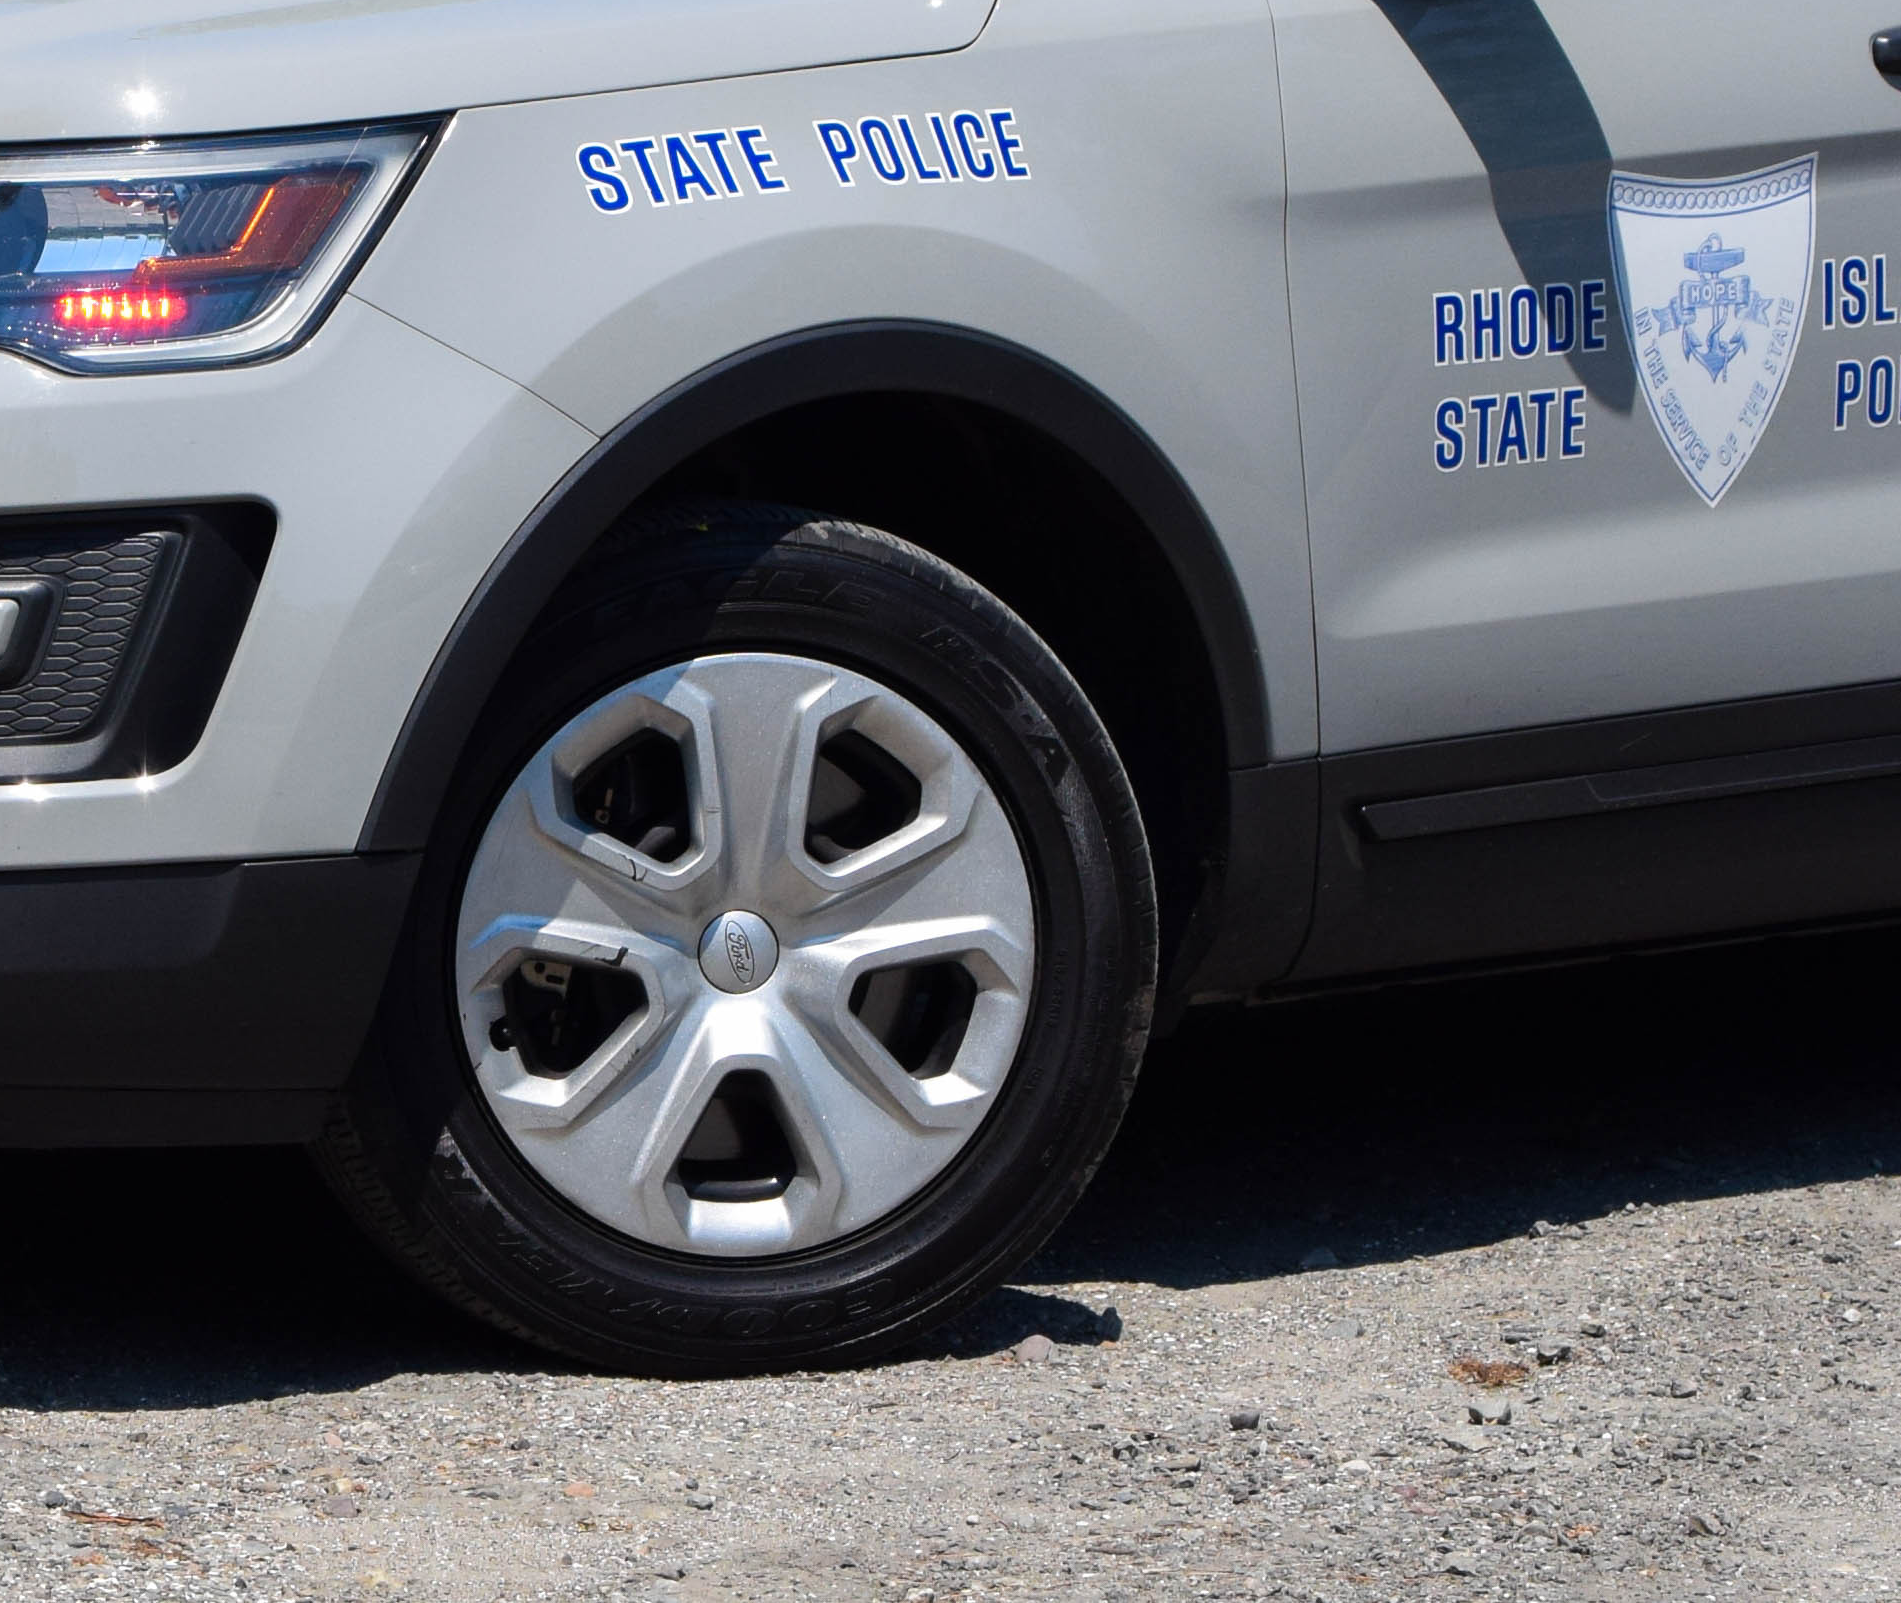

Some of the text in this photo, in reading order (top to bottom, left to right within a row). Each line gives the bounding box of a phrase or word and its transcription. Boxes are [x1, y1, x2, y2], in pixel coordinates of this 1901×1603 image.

[575, 107, 1031, 215] STATE POLICE
[1433, 279, 1607, 367] RHODE
[1689, 280, 1738, 302] HOPE
[1435, 384, 1587, 472] STATE
[1635, 297, 1795, 471] IN THE SERVICE OF THE STATE
[727, 931, 751, 974] Ford
